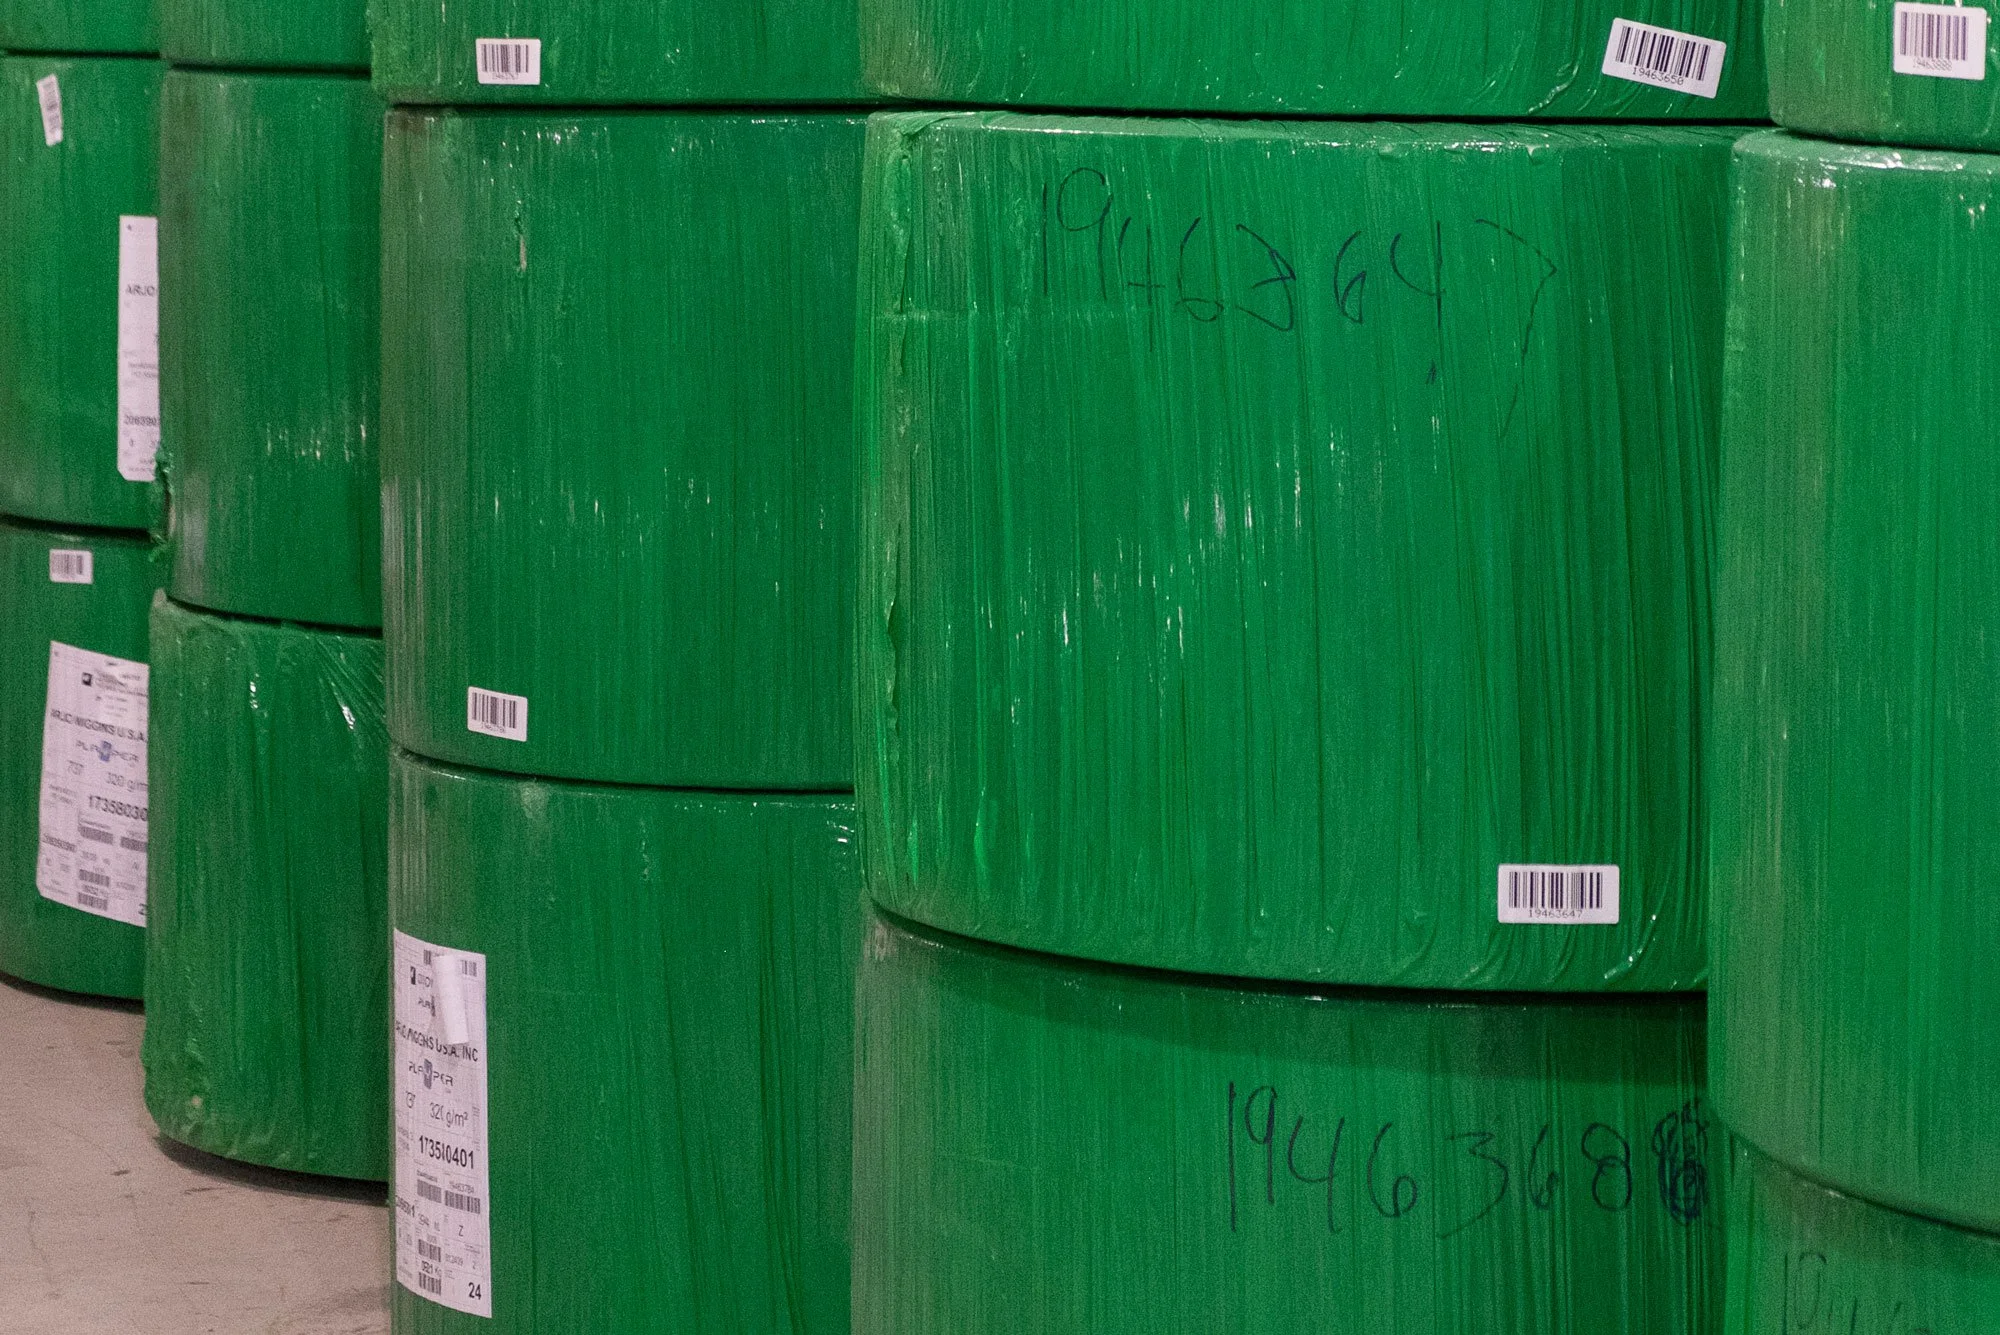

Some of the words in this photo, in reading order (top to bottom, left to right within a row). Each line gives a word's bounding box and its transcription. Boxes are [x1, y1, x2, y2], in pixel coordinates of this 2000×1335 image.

[1632, 66, 1684, 86] 19463650
[1529, 909, 1583, 919] 19463647
[467, 1281, 482, 1300] 24
